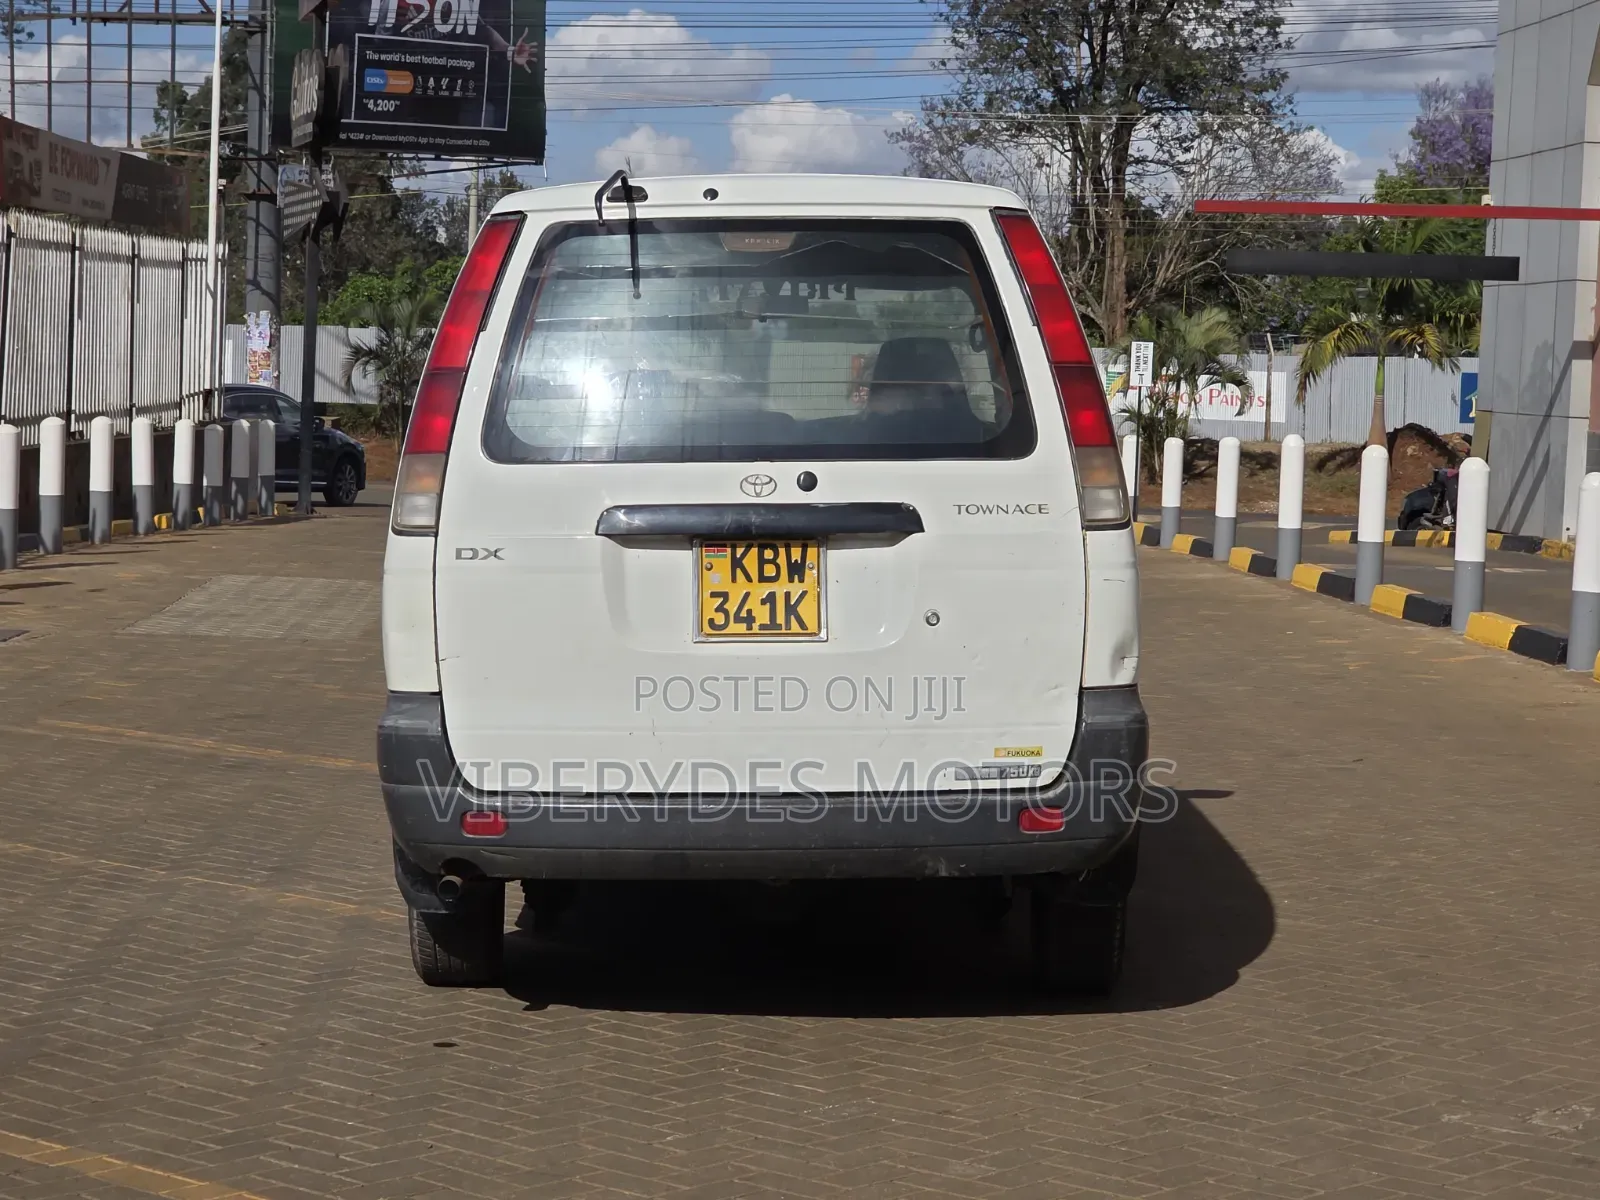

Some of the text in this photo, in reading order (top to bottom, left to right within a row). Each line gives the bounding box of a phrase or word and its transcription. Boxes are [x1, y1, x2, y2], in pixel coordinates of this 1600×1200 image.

[365, 50, 475, 70] The world's best football package
[372, 133, 398, 142] Download
[418, 136, 428, 144] App
[435, 137, 445, 146] stay
[455, 547, 506, 561] DX
[730, 541, 809, 584] KBW
[707, 590, 809, 631] 341K
